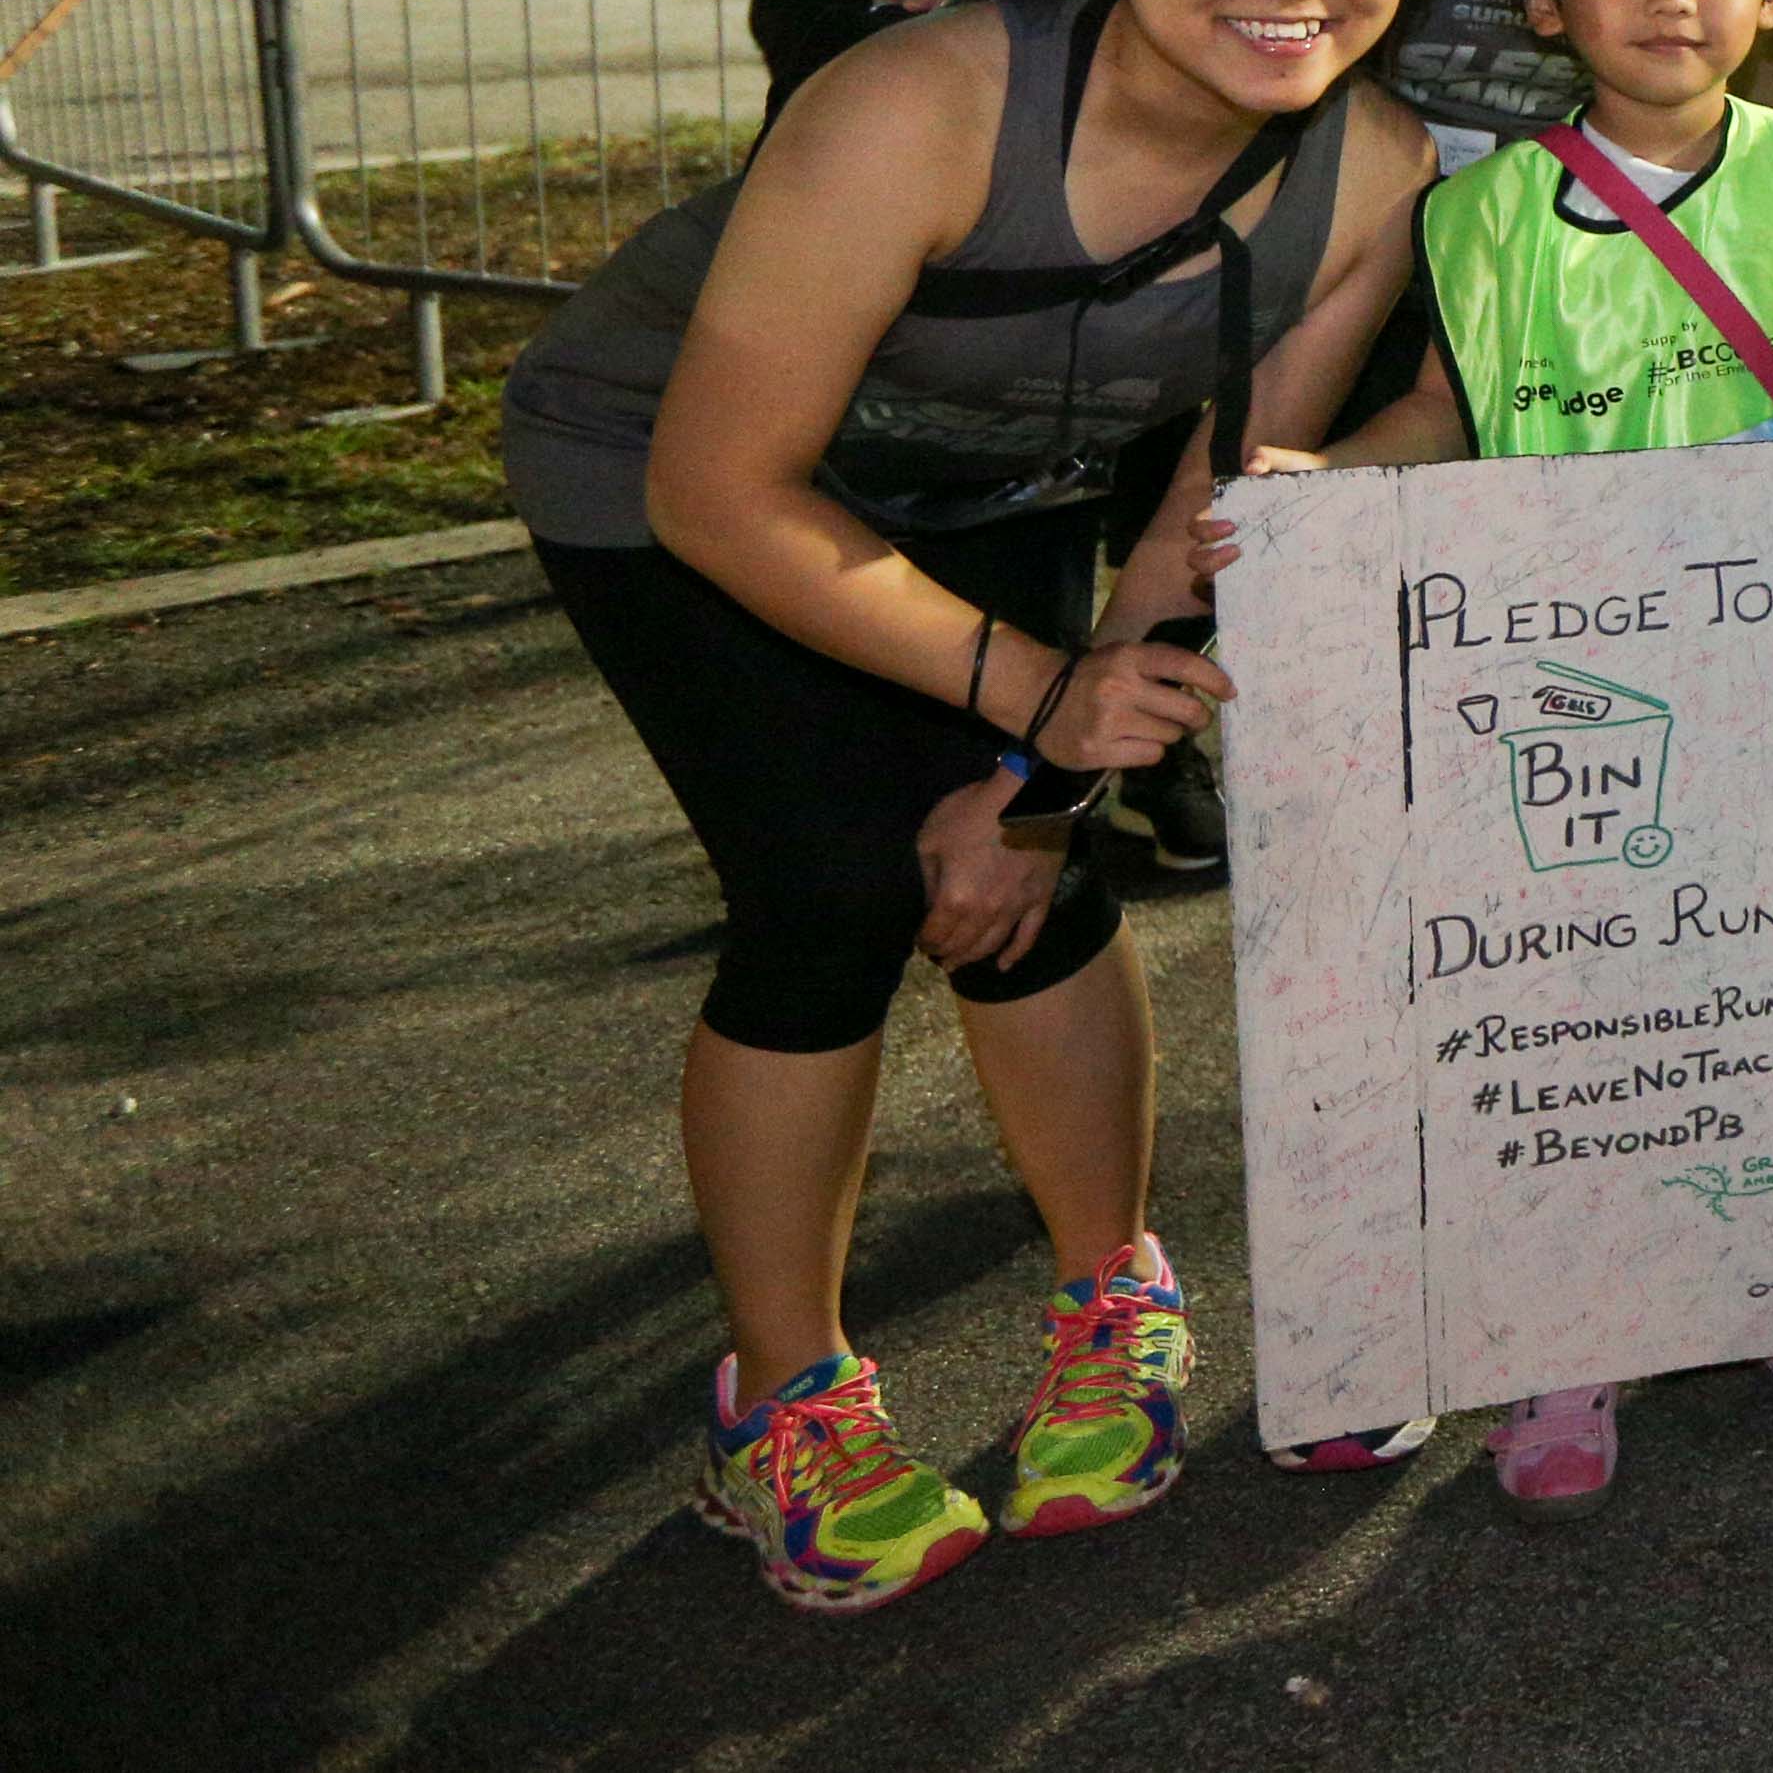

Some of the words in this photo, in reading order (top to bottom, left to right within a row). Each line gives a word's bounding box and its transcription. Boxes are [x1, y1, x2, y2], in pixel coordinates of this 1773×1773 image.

[1399, 42, 1585, 85] SLEE
[1409, 572, 1669, 651] PLEDGE
[1685, 558, 1773, 627] TO
[1548, 695, 1598, 717] GELS
[1518, 740, 1643, 808] BIN
[1564, 809, 1622, 848] IT
[1425, 914, 1639, 980] DURING
